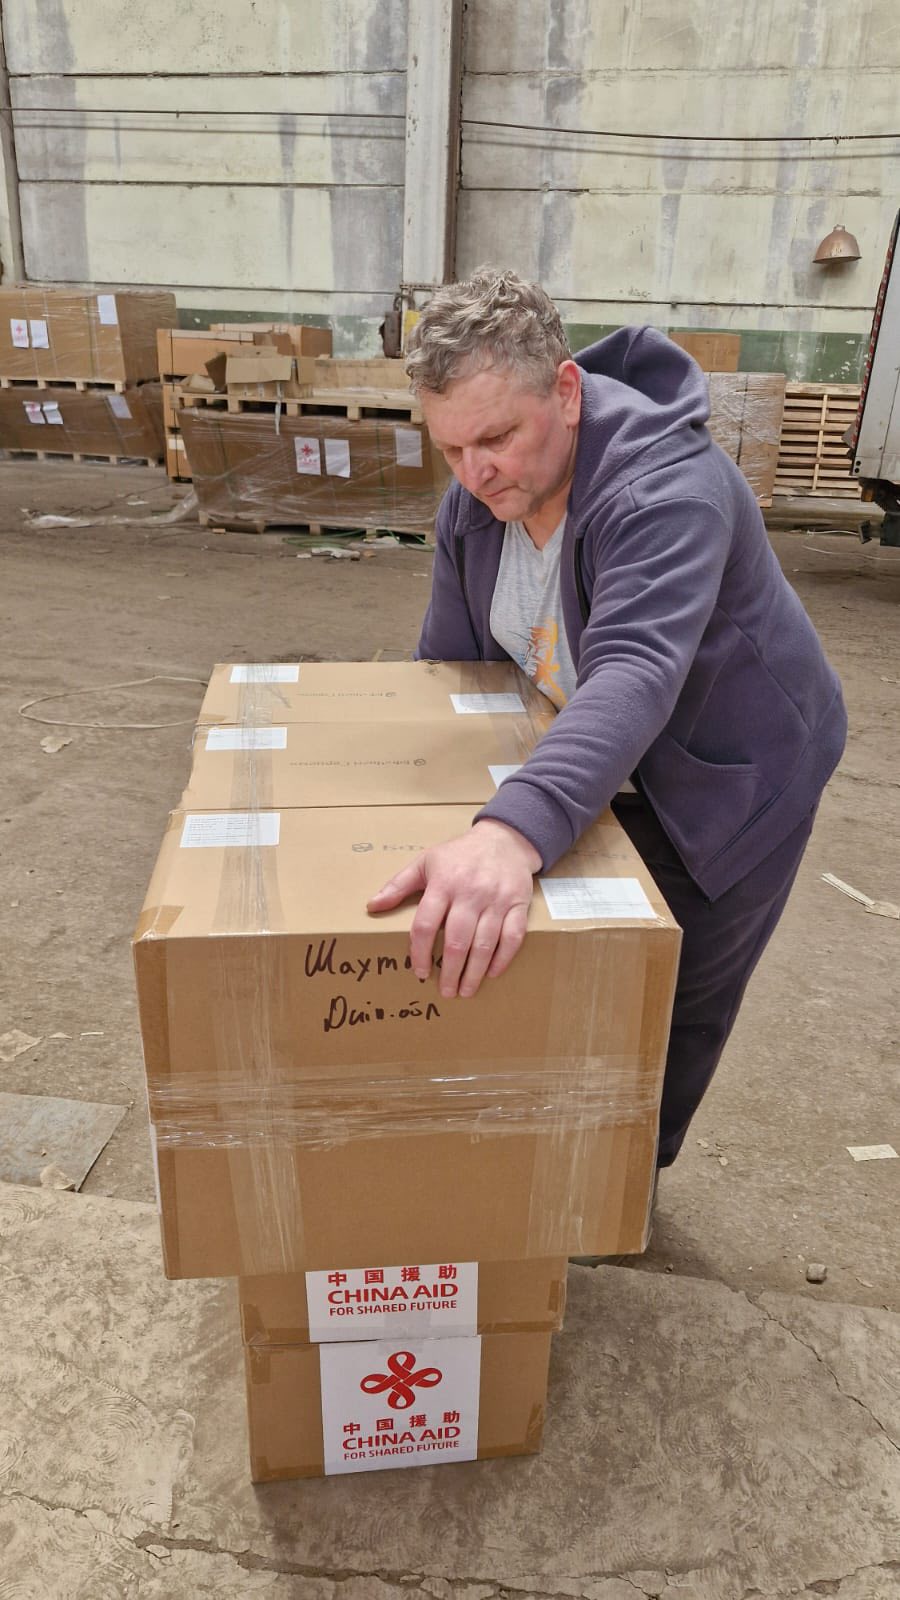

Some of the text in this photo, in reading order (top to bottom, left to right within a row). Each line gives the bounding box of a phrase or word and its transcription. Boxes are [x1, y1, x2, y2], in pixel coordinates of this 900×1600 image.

[328, 1264, 458, 1287] 中国援助
[328, 1283, 459, 1304] CHINA AID
[329, 1300, 457, 1316] FOR SHARED FUTURE
[343, 1410, 461, 1436] 中国援助
[342, 1426, 461, 1450] CHINA AID
[344, 1440, 460, 1461] FOR SHARED FUTURE
